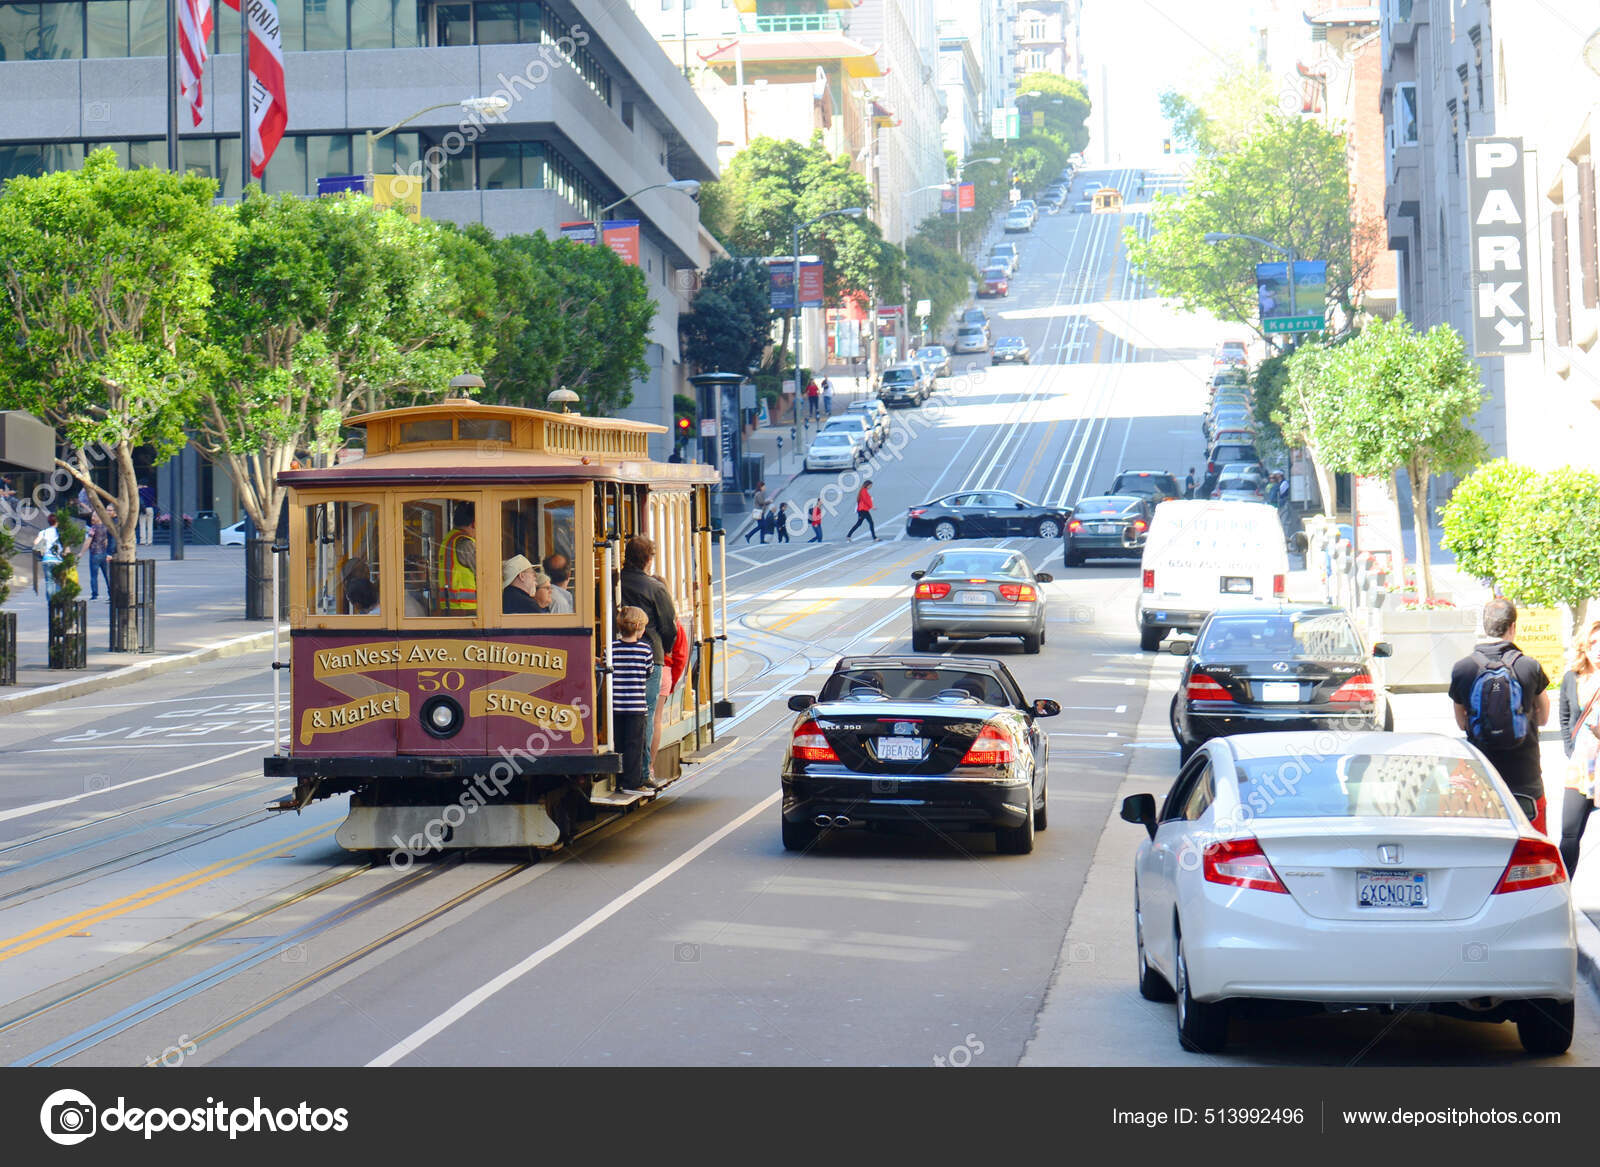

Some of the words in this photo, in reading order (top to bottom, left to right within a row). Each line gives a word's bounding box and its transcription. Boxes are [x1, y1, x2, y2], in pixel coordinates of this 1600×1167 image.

[1475, 143, 1525, 318] PARK
[1270, 320, 1318, 330] Kearny
[1516, 634, 1557, 642] PARKING
[1521, 624, 1550, 633] VALET
[319, 653, 352, 671] Van
[354, 647, 402, 667] Ness
[463, 644, 564, 671] California
[417, 670, 465, 692] 50
[312, 710, 327, 728] &
[329, 696, 401, 727] Market
[485, 692, 570, 724] Streets
[879, 744, 920, 757] 7BEA786
[1361, 884, 1423, 903] 6XCN078
